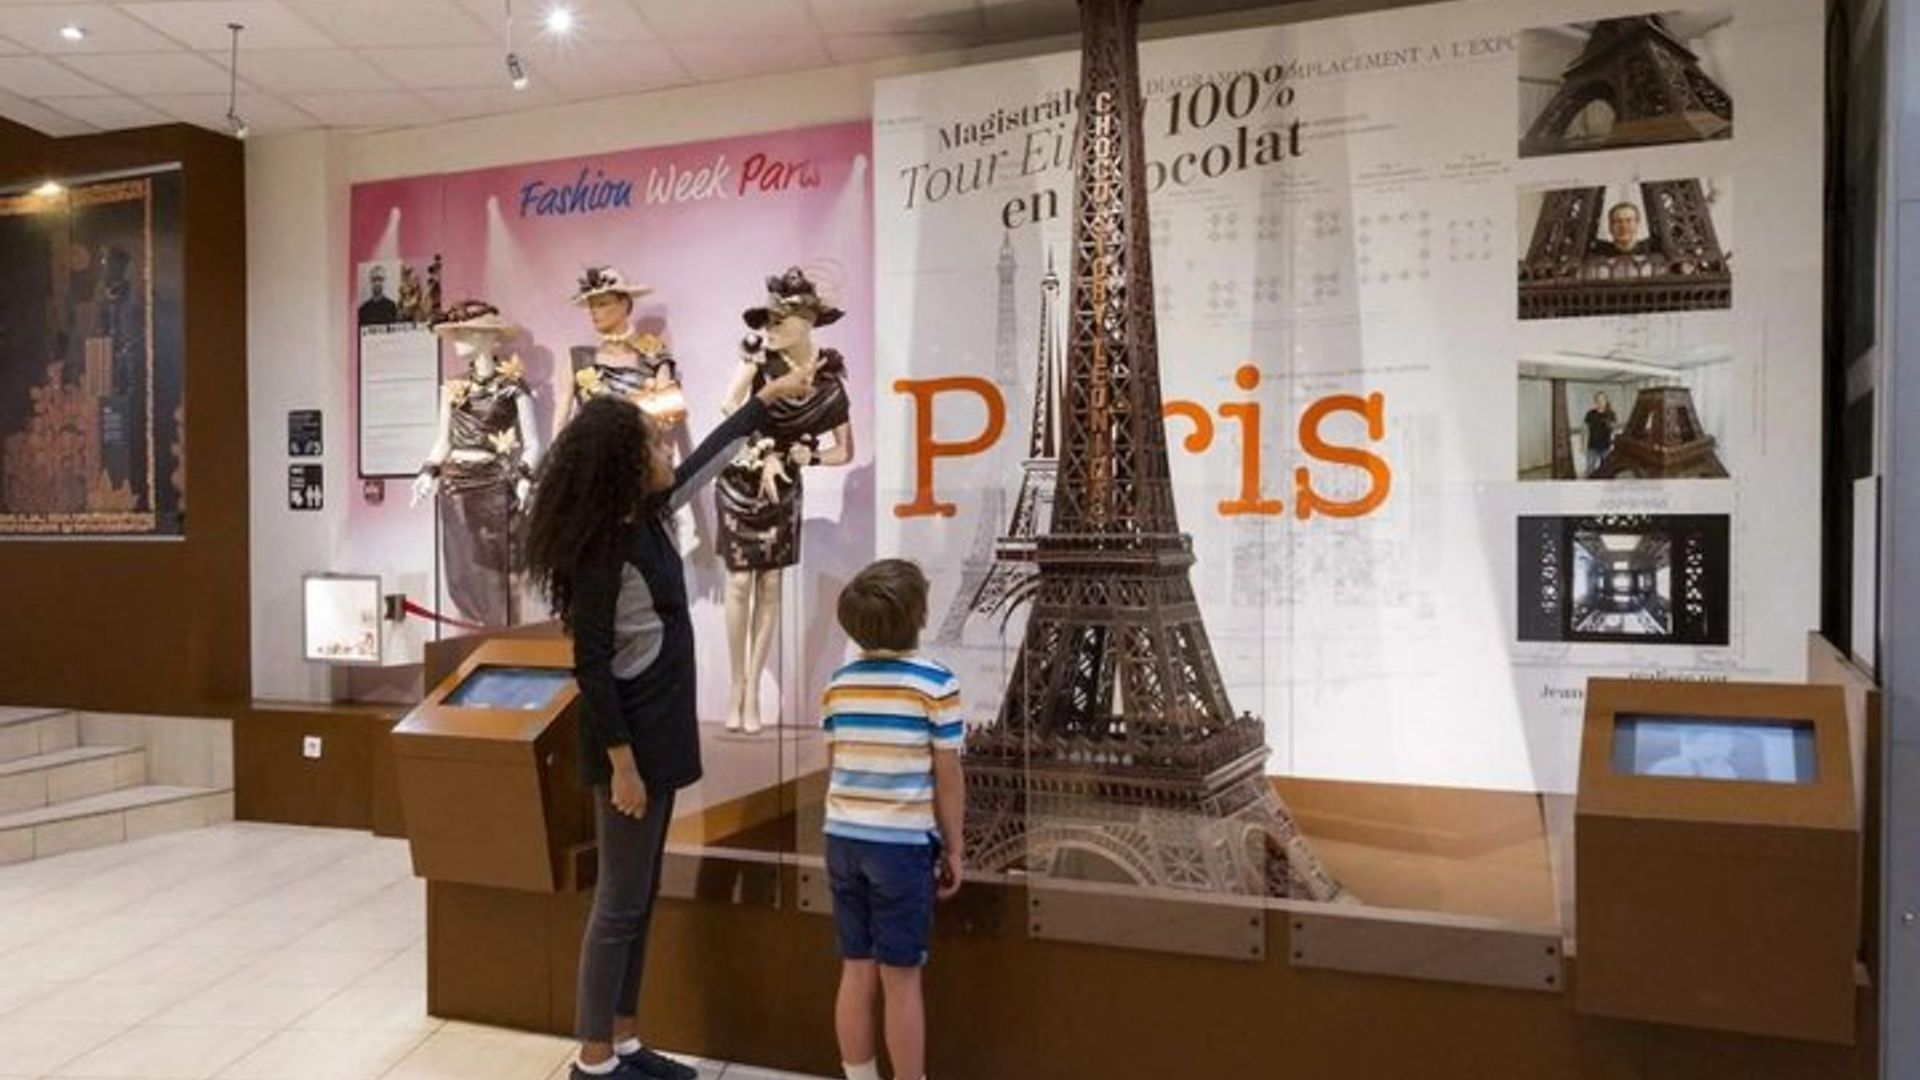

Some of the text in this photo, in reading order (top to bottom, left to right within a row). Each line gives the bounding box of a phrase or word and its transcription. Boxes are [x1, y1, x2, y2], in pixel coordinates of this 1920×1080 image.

[519, 151, 821, 218] Fashion Week Paris
[900, 150, 1009, 210] Tour
[1166, 58, 1299, 137] 100%
[1002, 186, 1058, 230] en
[1145, 117, 1305, 192] ocolat
[893, 363, 1392, 519] Pris
